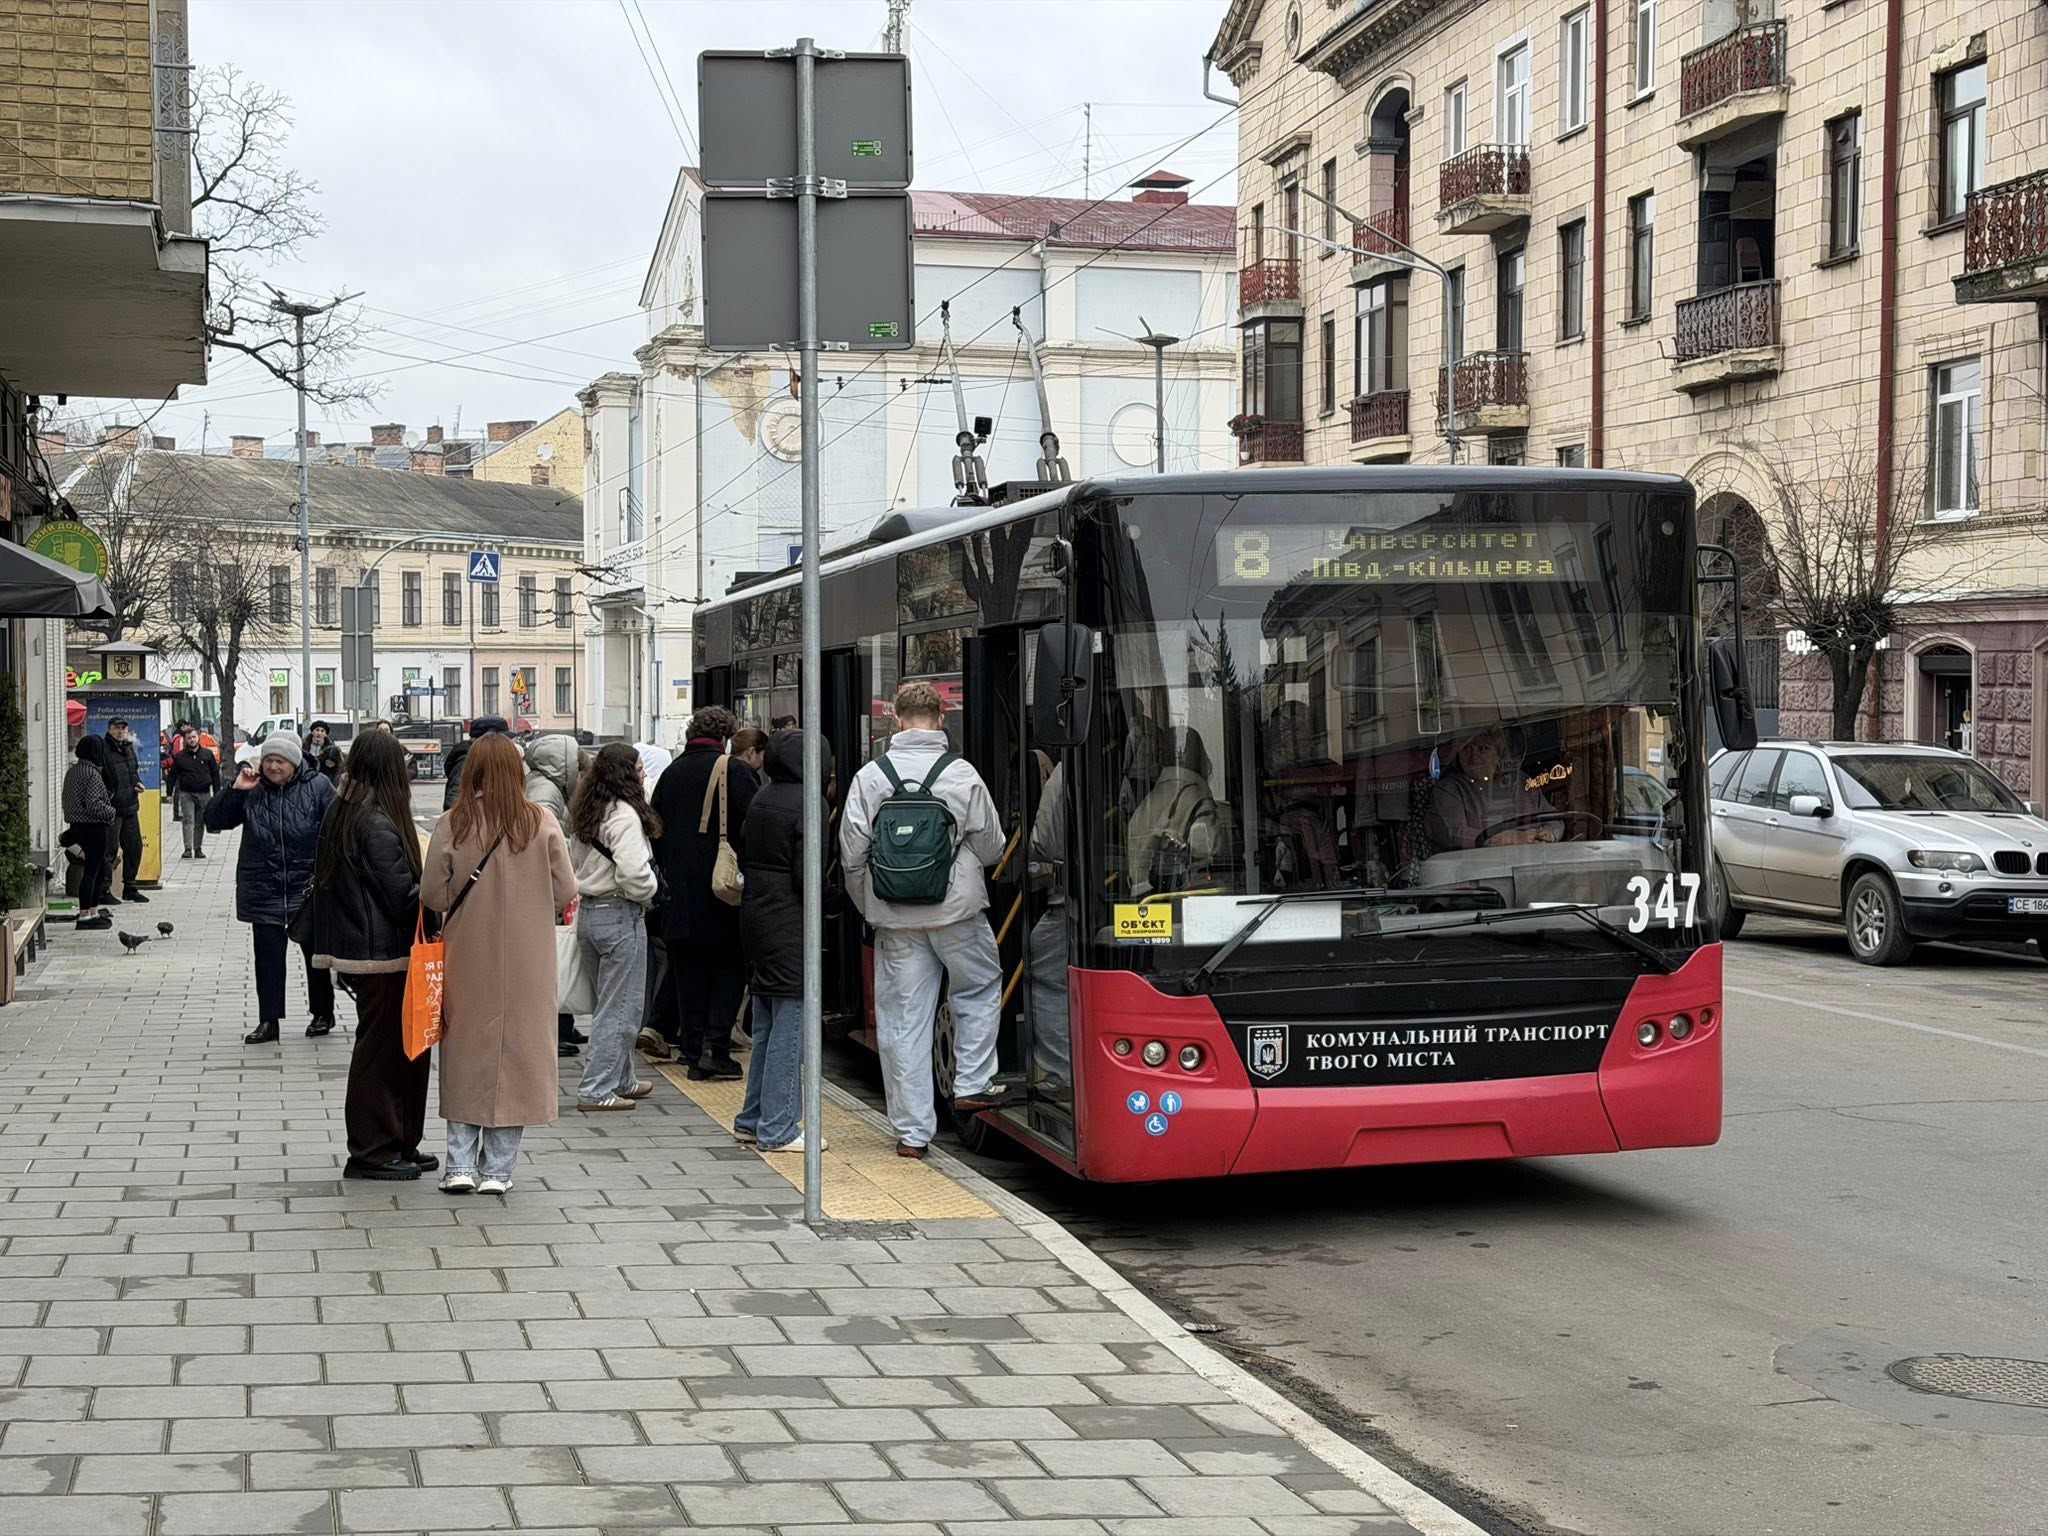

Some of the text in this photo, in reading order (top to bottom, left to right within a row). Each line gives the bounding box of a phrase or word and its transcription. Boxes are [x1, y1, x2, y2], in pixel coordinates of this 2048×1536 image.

[1234, 531, 1270, 579] 8
[1626, 872, 1701, 933] 347
[1306, 1024, 1609, 1048] КОМУНАЛЬНИЙ ТРАНСПОРТ
[1306, 1052, 1456, 1071] ТВОГО МІСТА
